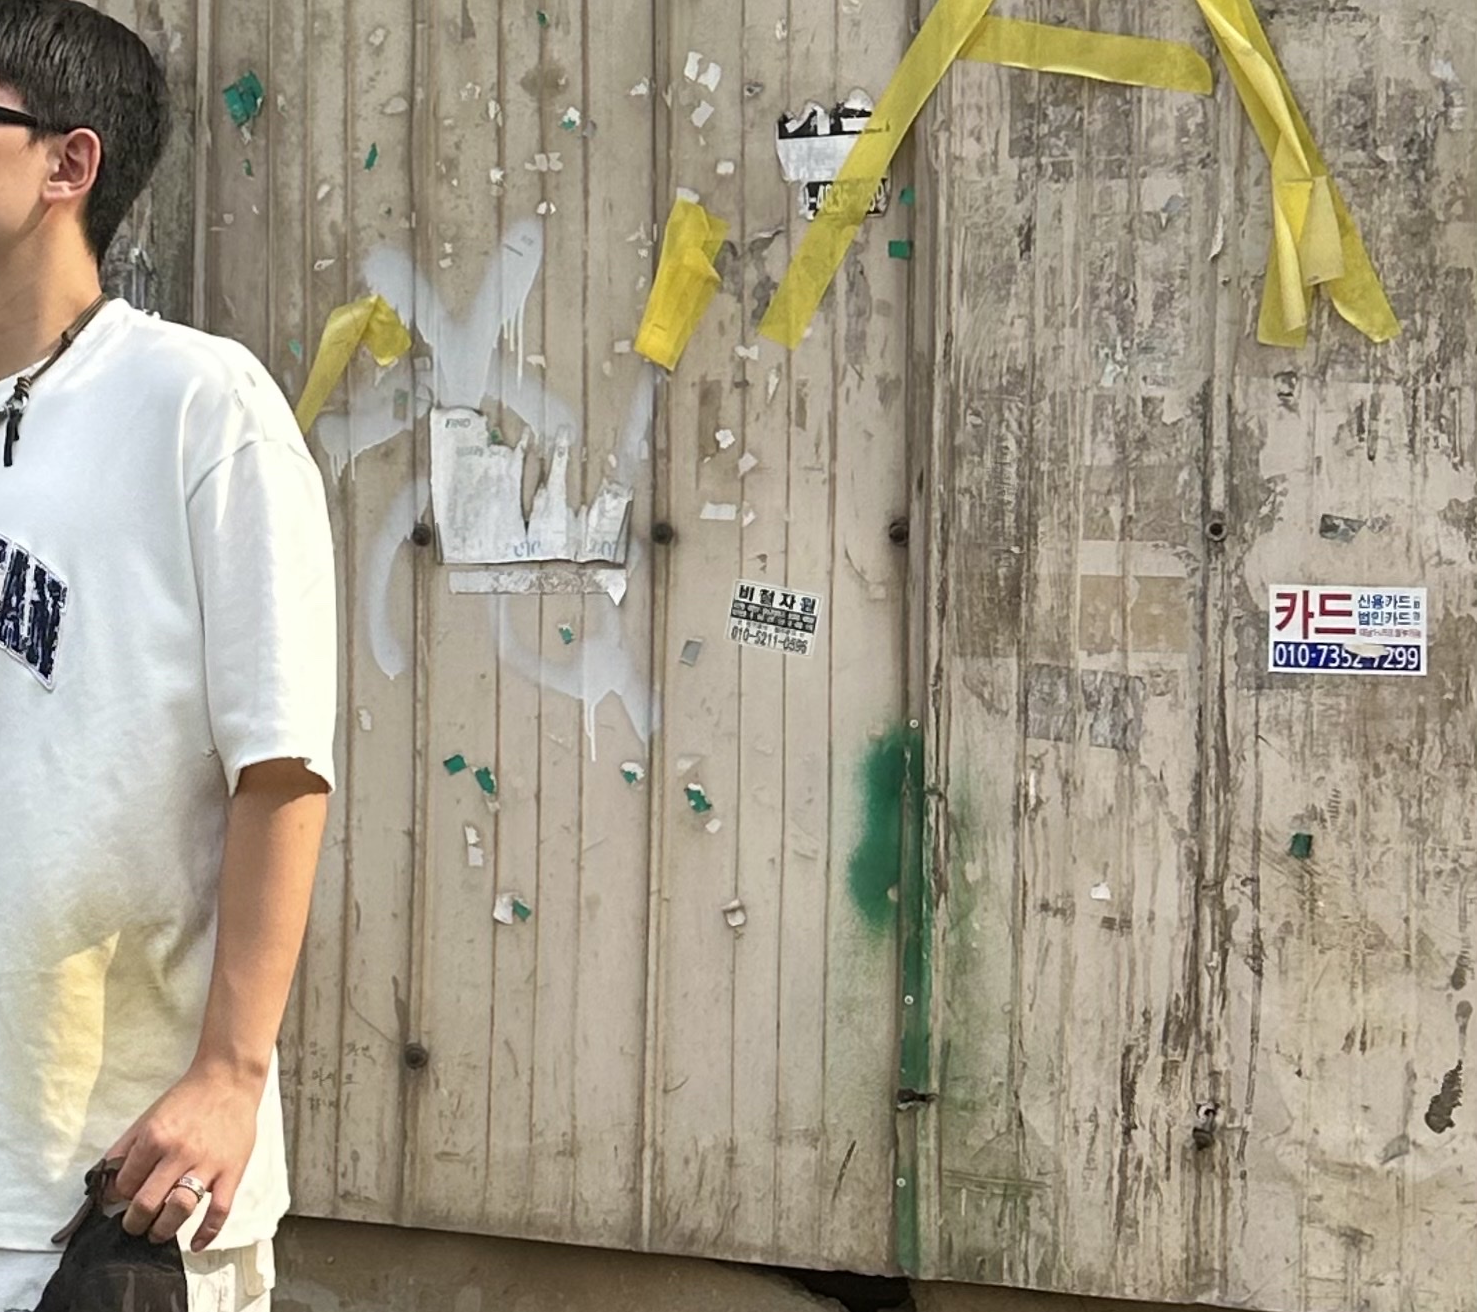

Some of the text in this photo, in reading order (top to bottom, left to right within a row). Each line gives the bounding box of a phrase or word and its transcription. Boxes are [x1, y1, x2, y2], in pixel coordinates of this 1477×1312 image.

[1275, 590, 1412, 640] 카드 신용카드
[1357, 611, 1412, 627] 법인카드
[1274, 642, 1420, 670] 010-7352299
